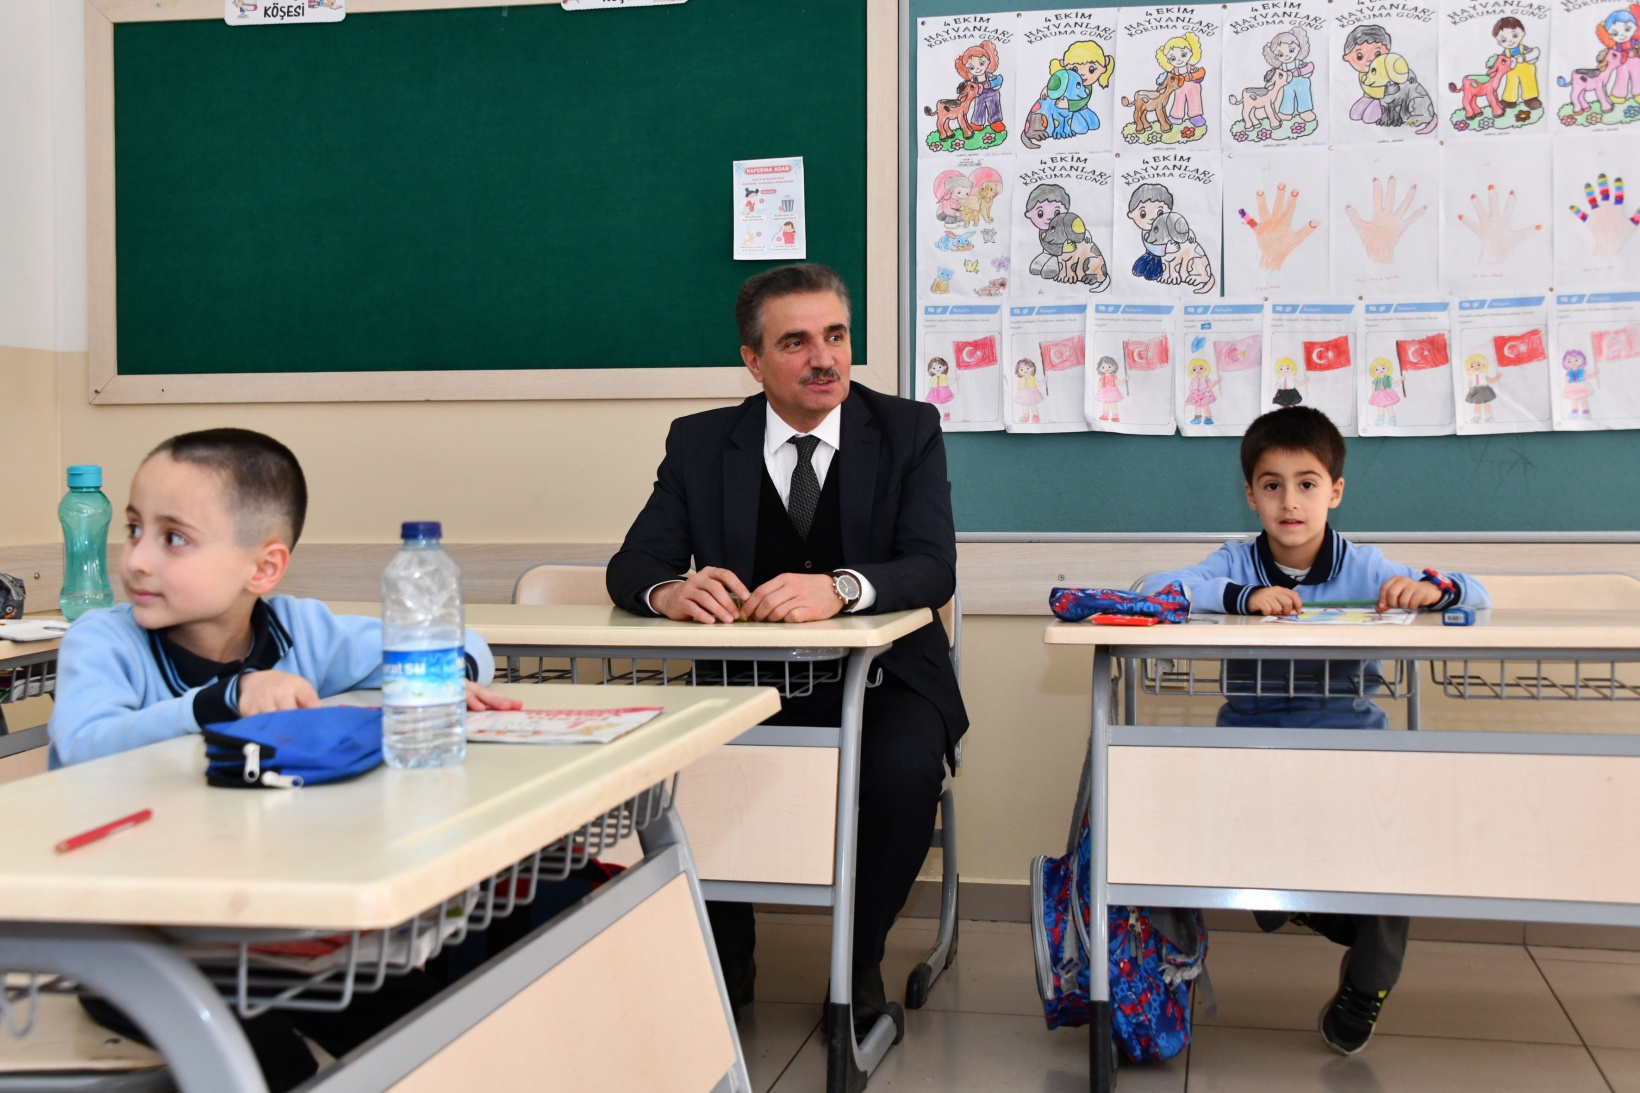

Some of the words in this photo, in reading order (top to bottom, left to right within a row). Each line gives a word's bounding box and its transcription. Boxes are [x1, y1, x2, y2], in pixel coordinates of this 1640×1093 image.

[264, 3, 305, 20] KÖŞESİ
[1156, 6, 1196, 15] EKİM
[1262, 1, 1303, 10] EKİM
[1335, 3, 1436, 23] HAYVANLARI
[1447, 0, 1552, 20] HAYVANLARI
[953, 15, 991, 24] EKİM
[1054, 11, 1093, 21] EKİM
[1123, 16, 1220, 32] HAYVANLARI
[1229, 11, 1327, 29] HAYVANLARI
[1339, 12, 1392, 28] KORUMA
[1396, 12, 1432, 23] GÜNÜ
[1450, 9, 1505, 26] KORUMA
[1510, 8, 1548, 20] GÜNÜ
[923, 25, 1015, 43] HAYVANLARI
[1023, 21, 1116, 39] HAYVANLARI
[1127, 24, 1177, 38] KORUMA
[1182, 24, 1216, 37] GÜNÜ
[1233, 20, 1284, 35] KORUMA
[1288, 19, 1324, 31] GÜNÜ
[926, 34, 975, 48] KORUMA
[979, 33, 1011, 44] GÜNÜ
[1027, 29, 1076, 44] KORUMA
[1080, 30, 1113, 41] GÜNÜ
[1050, 154, 1089, 164] EKİM
[1152, 154, 1192, 163] EKİM
[1019, 165, 1112, 181] HAYVANLARI
[1022, 173, 1072, 186] KORUMA
[1075, 173, 1109, 186] GÜNÜ
[1120, 164, 1216, 180] HAYVANLARI
[1124, 172, 1175, 186] KORUMA
[1178, 172, 1212, 185] GÜNÜ
